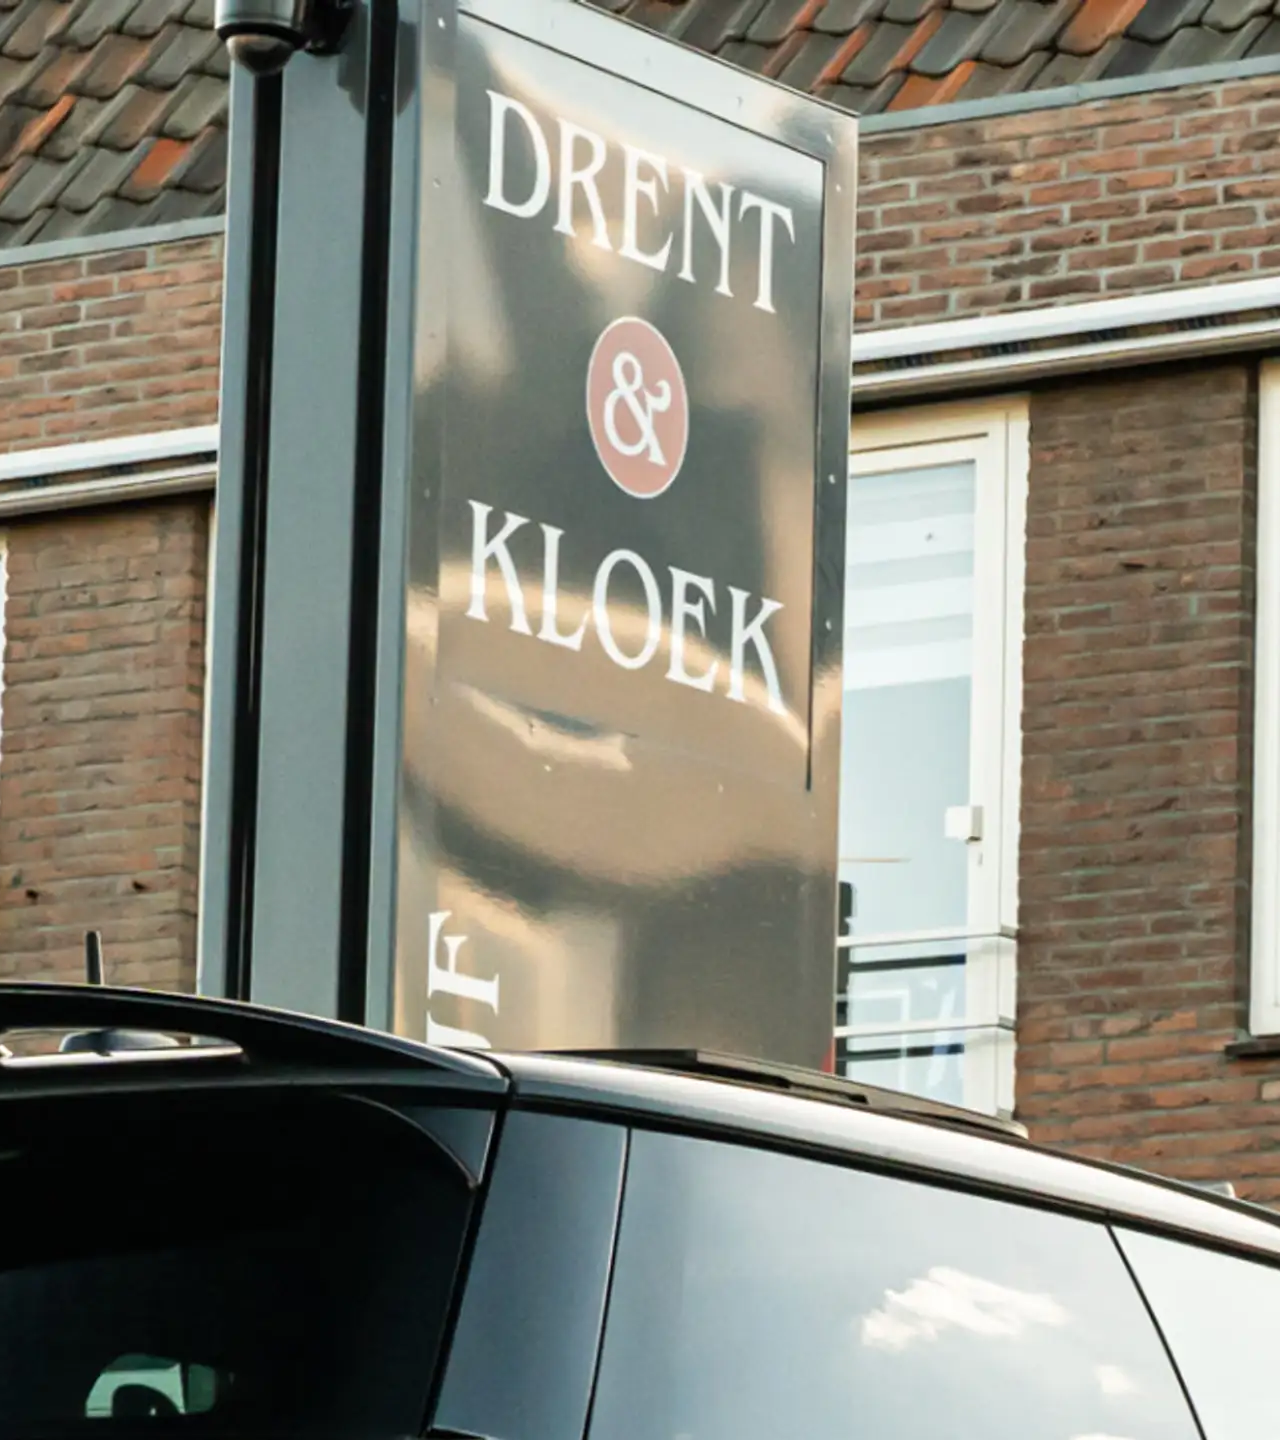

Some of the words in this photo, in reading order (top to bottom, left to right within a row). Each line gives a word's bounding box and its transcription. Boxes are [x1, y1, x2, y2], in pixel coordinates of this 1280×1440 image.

[482, 88, 796, 314] DRENT
[603, 351, 671, 467] &
[465, 498, 787, 718] KLOEK
